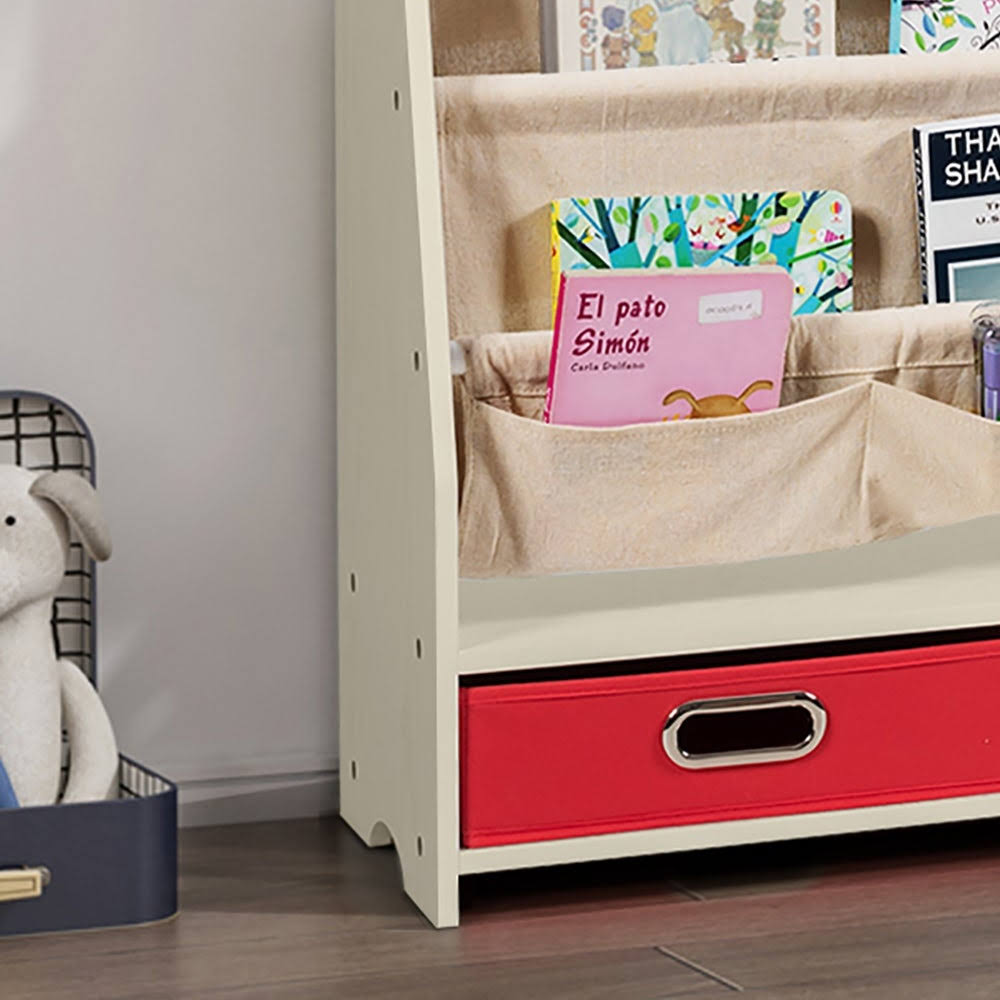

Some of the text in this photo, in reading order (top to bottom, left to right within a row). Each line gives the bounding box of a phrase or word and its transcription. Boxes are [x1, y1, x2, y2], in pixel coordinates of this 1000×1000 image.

[577, 293, 666, 326] El pato
[572, 328, 650, 356] Simón
[570, 361, 599, 372] Carla
